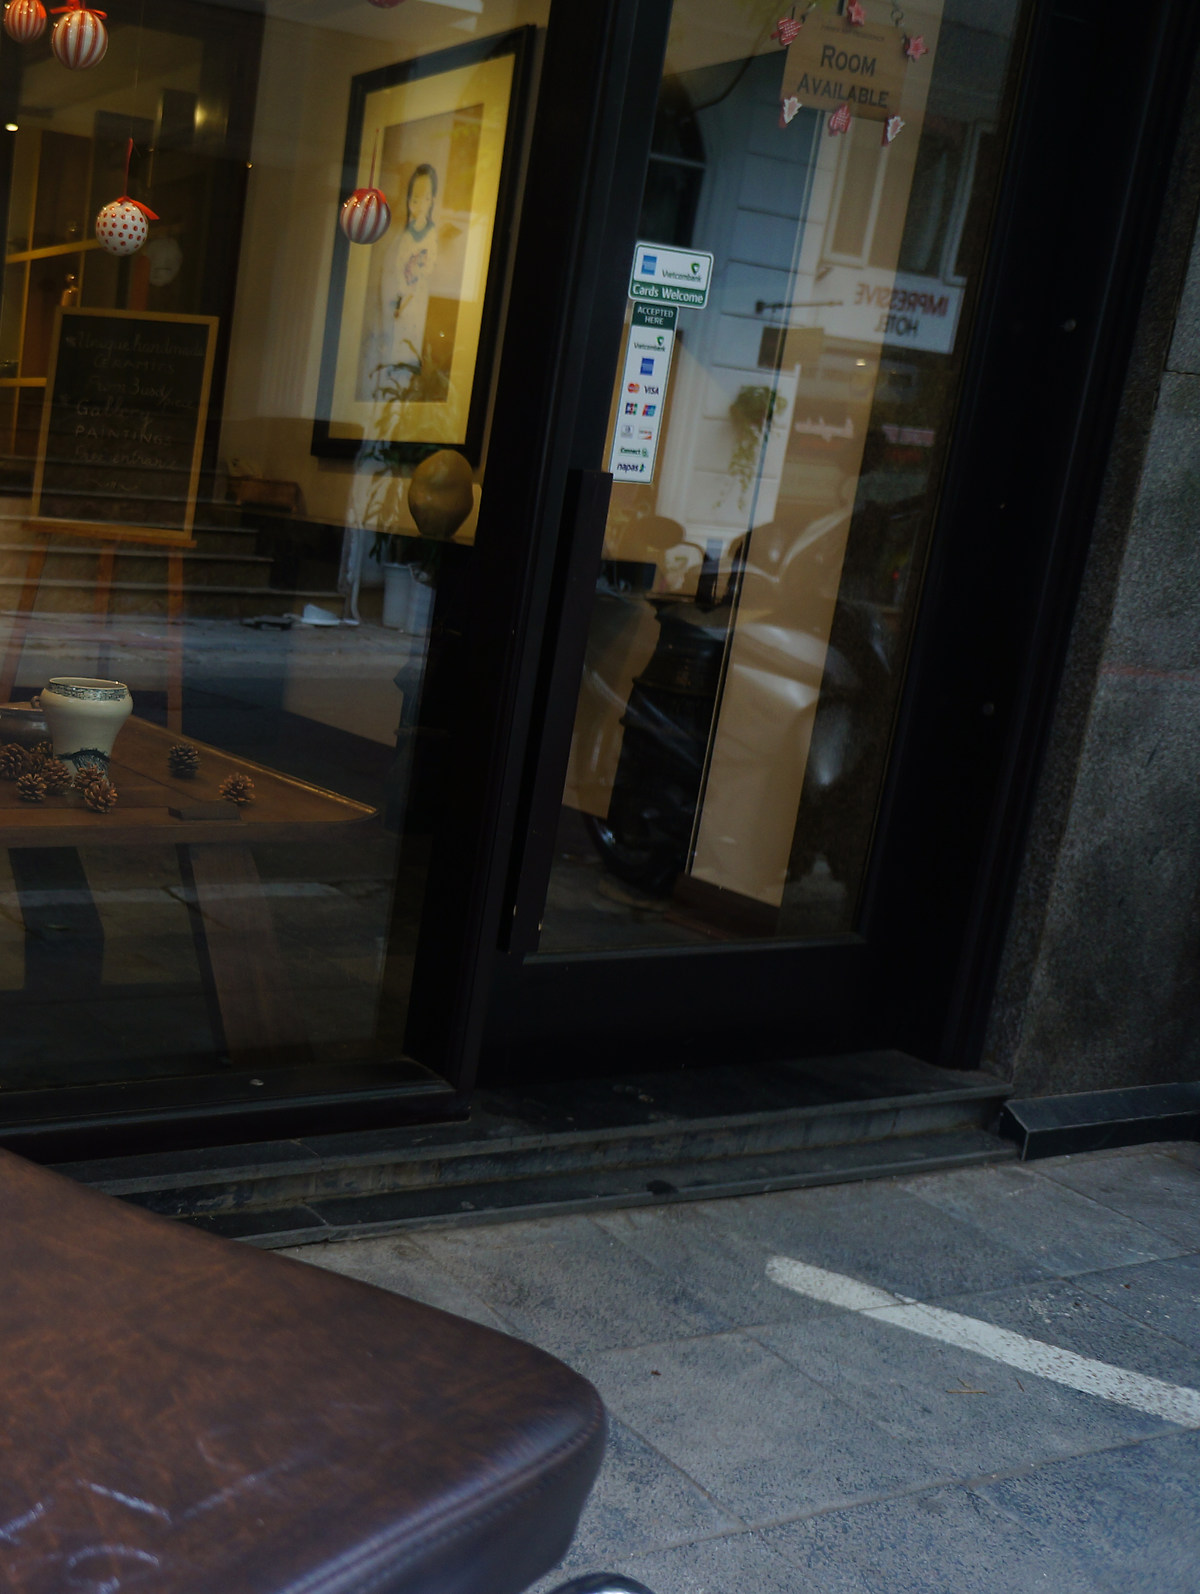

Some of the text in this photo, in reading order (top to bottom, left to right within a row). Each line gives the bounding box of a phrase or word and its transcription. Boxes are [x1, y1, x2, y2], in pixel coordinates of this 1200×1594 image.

[820, 44, 877, 77] ROOM
[797, 73, 889, 108] AVAILABLE
[632, 284, 704, 304] Cards Welcome
[637, 306, 674, 318] ACCEPTED
[644, 315, 664, 325] HERE
[644, 385, 659, 395] VISA
[616, 463, 639, 473] napas
